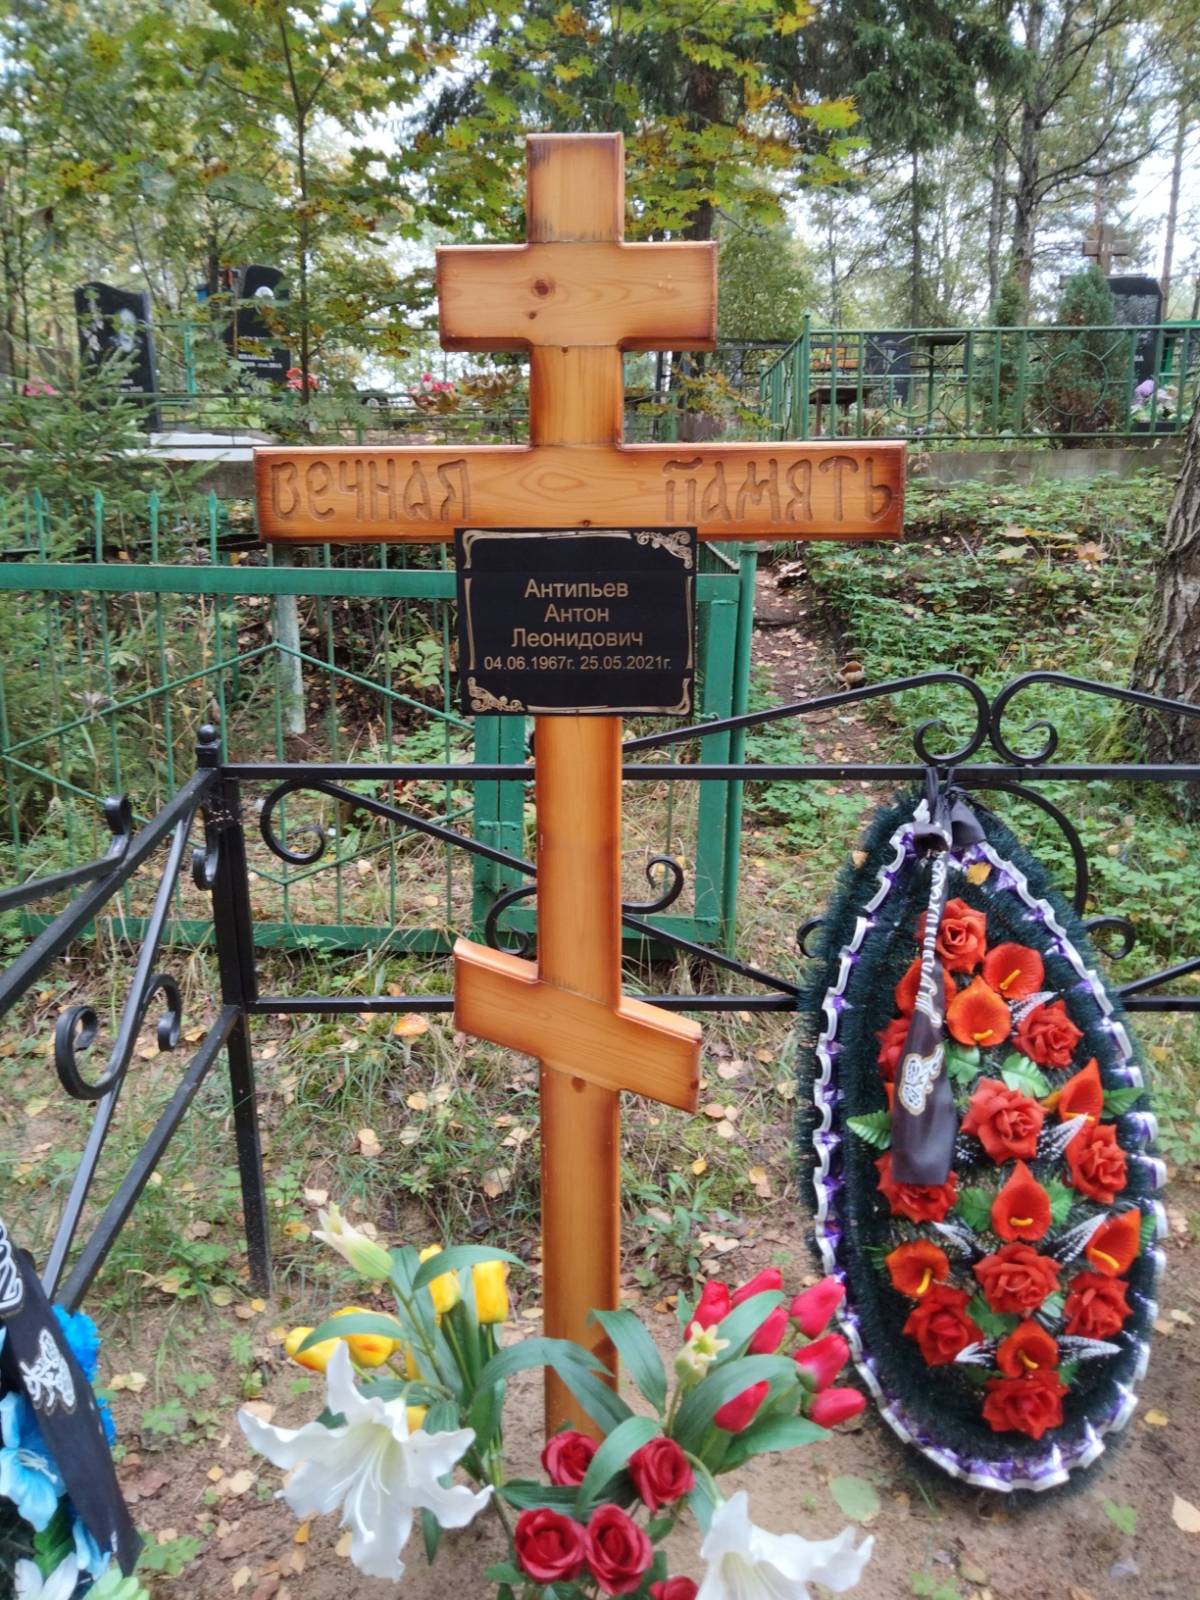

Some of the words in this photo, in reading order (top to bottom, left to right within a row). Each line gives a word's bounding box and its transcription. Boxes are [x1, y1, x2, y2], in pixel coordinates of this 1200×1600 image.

[661, 455, 893, 523] ПАМЯТЬ
[524, 579, 629, 599] Антипьев
[544, 603, 610, 623] Антон
[511, 627, 643, 650] Леонидович
[484, 655, 576, 671] 04.06.1967г.
[580, 655, 672, 671] 25.05.2021г.
